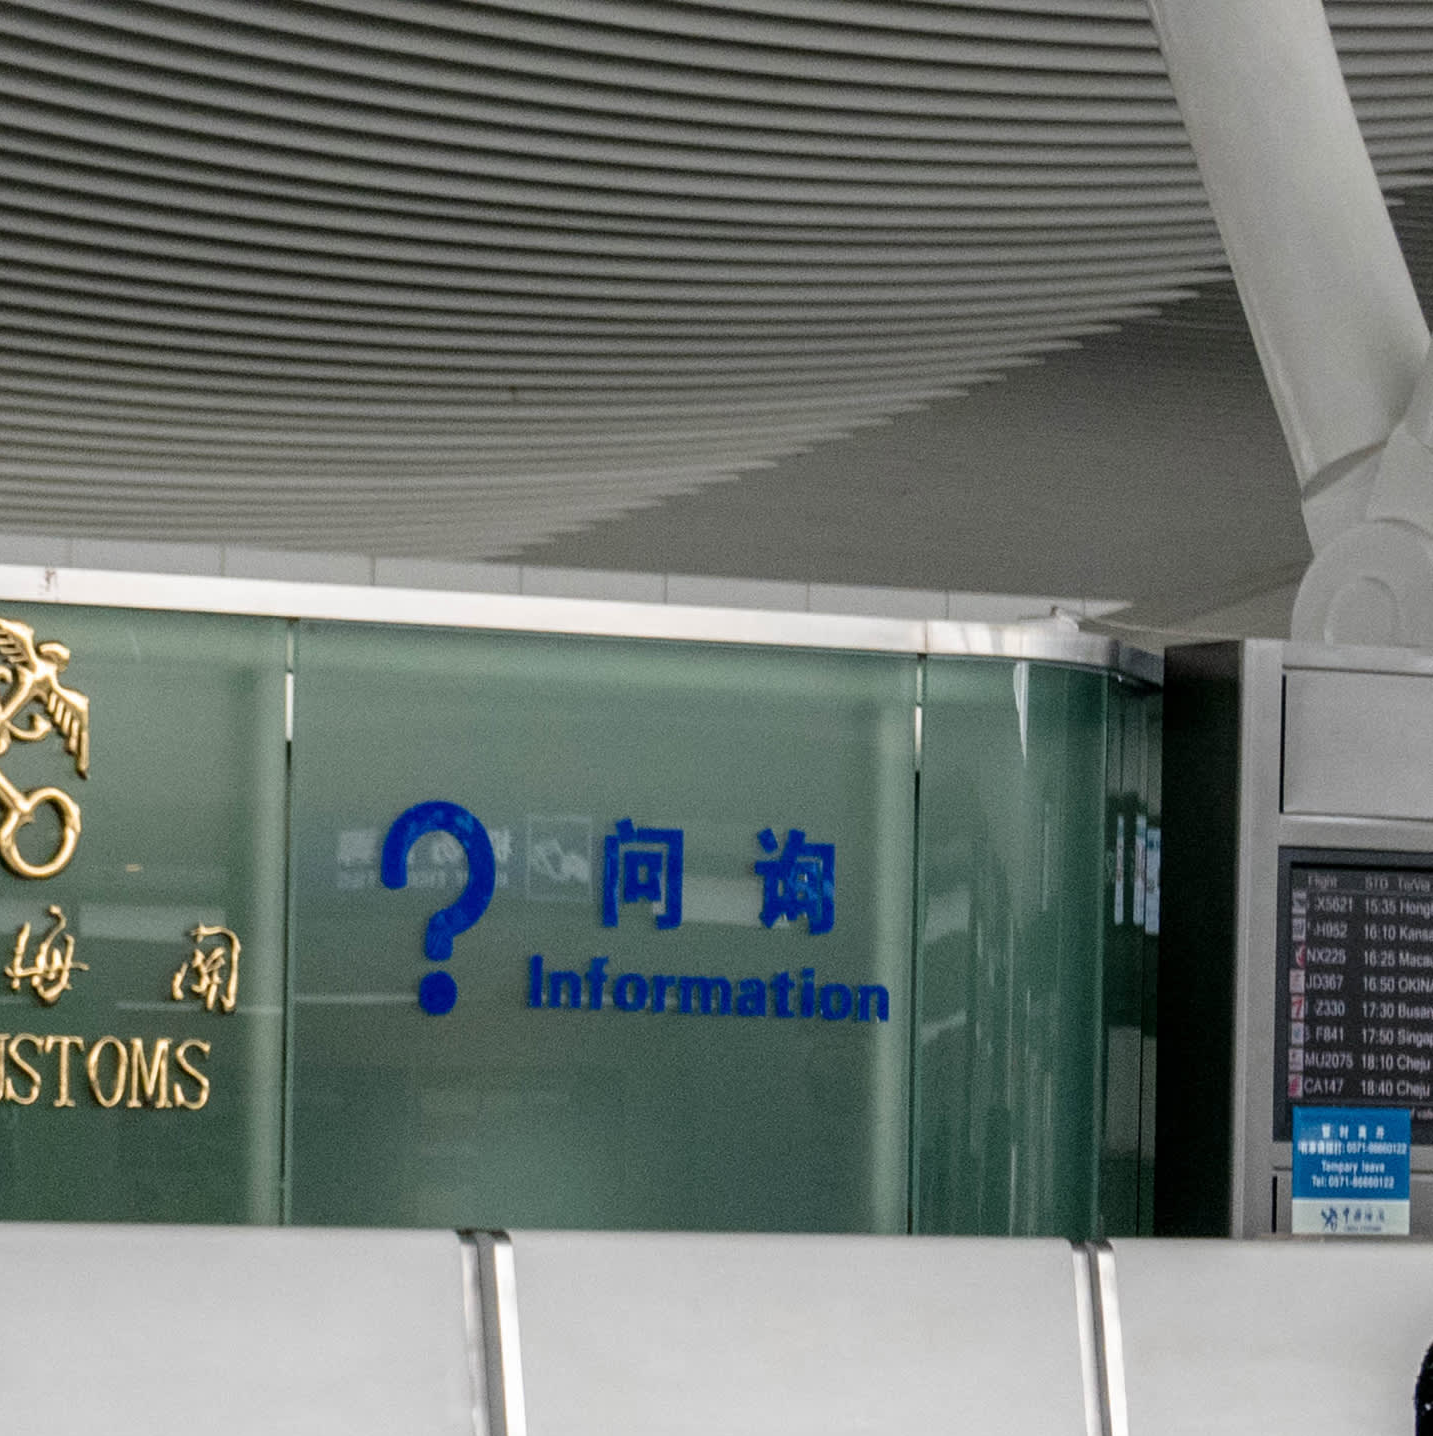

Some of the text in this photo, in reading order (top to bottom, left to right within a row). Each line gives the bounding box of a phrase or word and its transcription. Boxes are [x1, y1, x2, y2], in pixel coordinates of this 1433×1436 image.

[602, 818, 836, 935] 问询
[1364, 898, 1396, 915] 15:35
[1363, 923, 1396, 940] 16:10
[527, 954, 891, 1023] Information
[1363, 1001, 1394, 1018] 17:30
[1362, 1054, 1393, 1070] 18:10
[1303, 1078, 1344, 1095] CA147
[1361, 1080, 1393, 1096] 18:40
